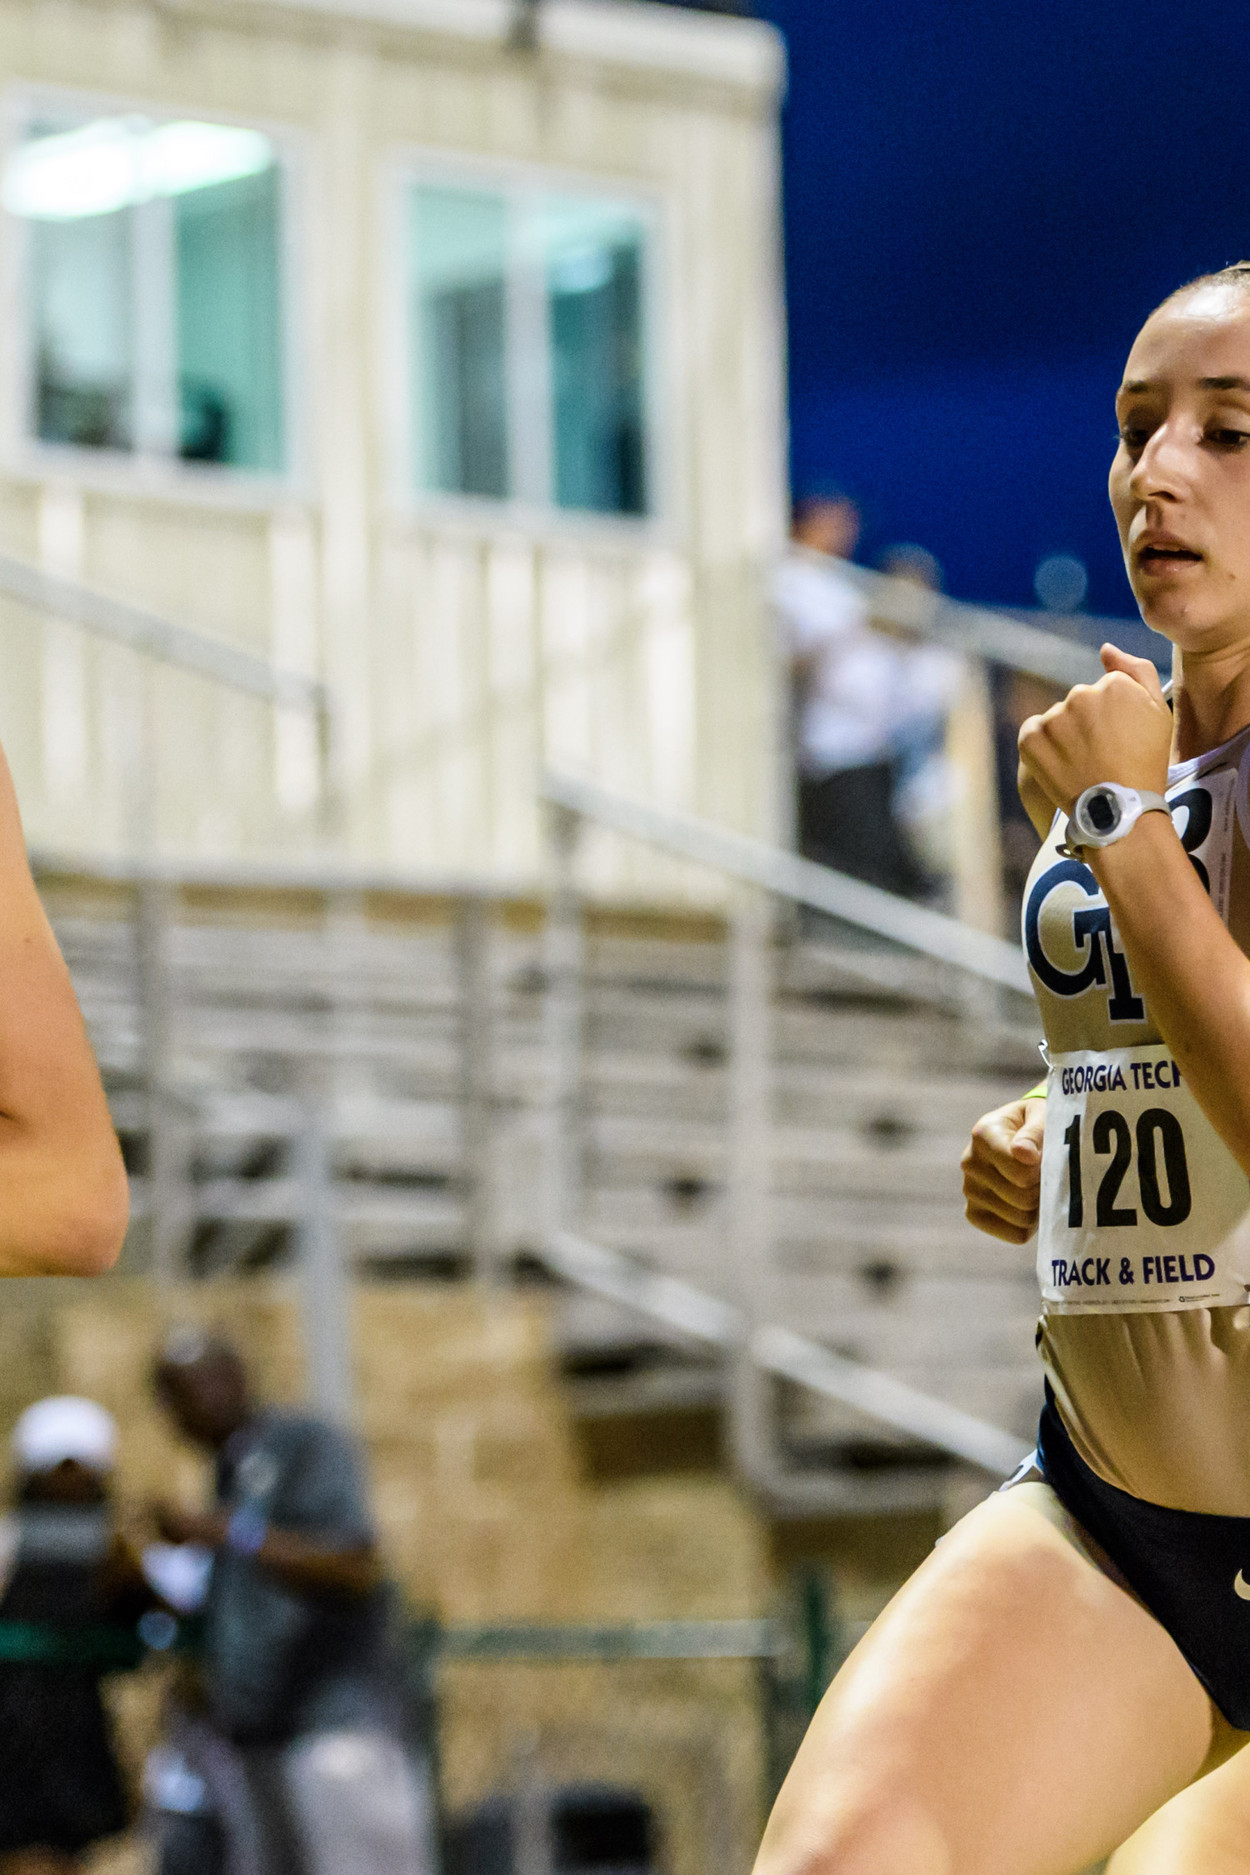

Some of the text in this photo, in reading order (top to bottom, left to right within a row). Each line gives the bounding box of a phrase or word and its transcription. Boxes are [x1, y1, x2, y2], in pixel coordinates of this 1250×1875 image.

[1061, 1064, 1127, 1095] GEORGIA
[1063, 1107, 1192, 1228] 120
[1051, 1253, 1215, 1287] TRACK & FIELD
